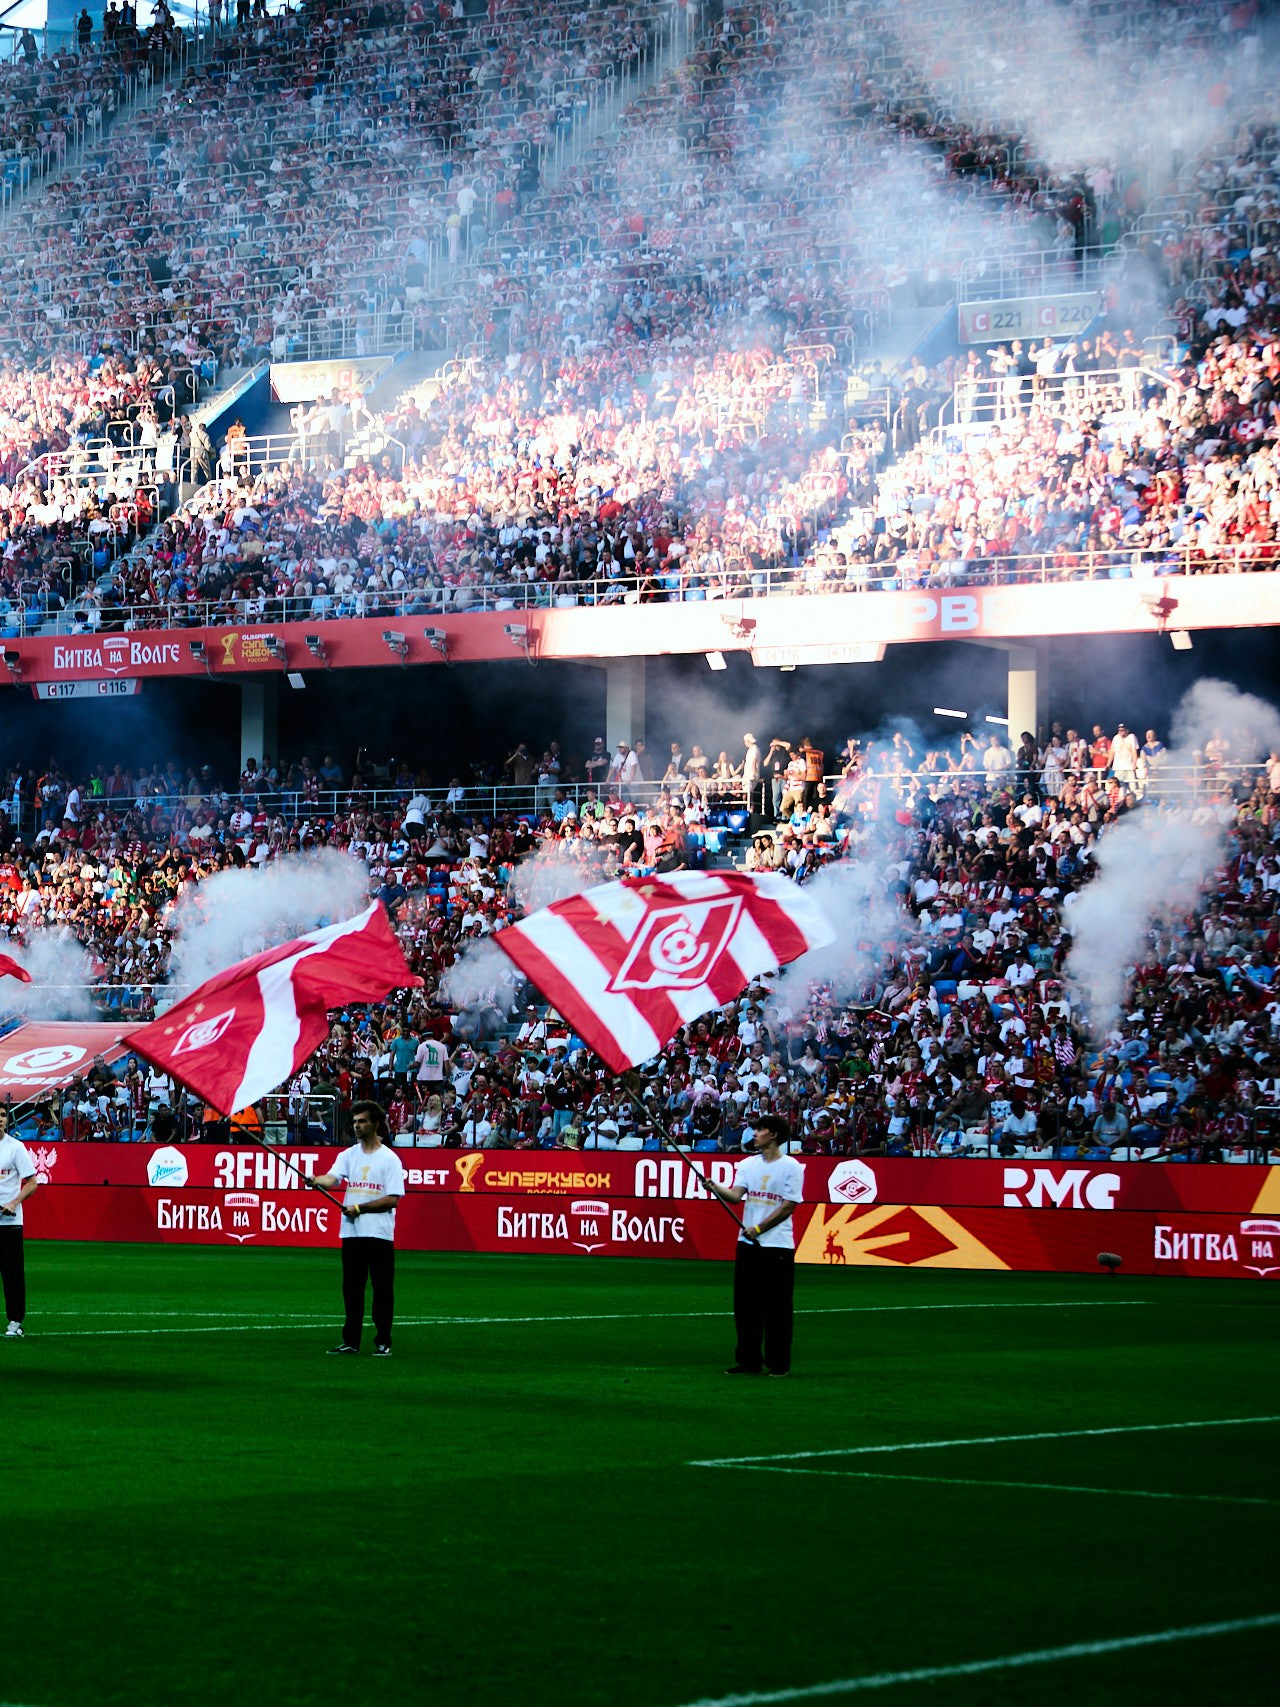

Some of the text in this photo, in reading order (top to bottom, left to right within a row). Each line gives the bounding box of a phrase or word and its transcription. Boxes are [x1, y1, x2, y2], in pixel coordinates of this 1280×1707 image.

[992, 311, 1023, 329] 221
[242, 633, 274, 641] OLIMPBET
[54, 646, 102, 669] Битва
[130, 641, 180, 665] Волге
[59, 682, 76, 696] 117
[111, 681, 127, 694] 116
[214, 1151, 319, 1190] ЗЕНИТ
[484, 1170, 611, 1189] СУПЕРКУБОК
[1003, 1167, 1121, 1210] RMG
[157, 1198, 223, 1230] Битва
[261, 1201, 329, 1233] Волге
[497, 1206, 569, 1240] Битва
[611, 1209, 685, 1244] Волге
[1154, 1225, 1239, 1262] Битва
